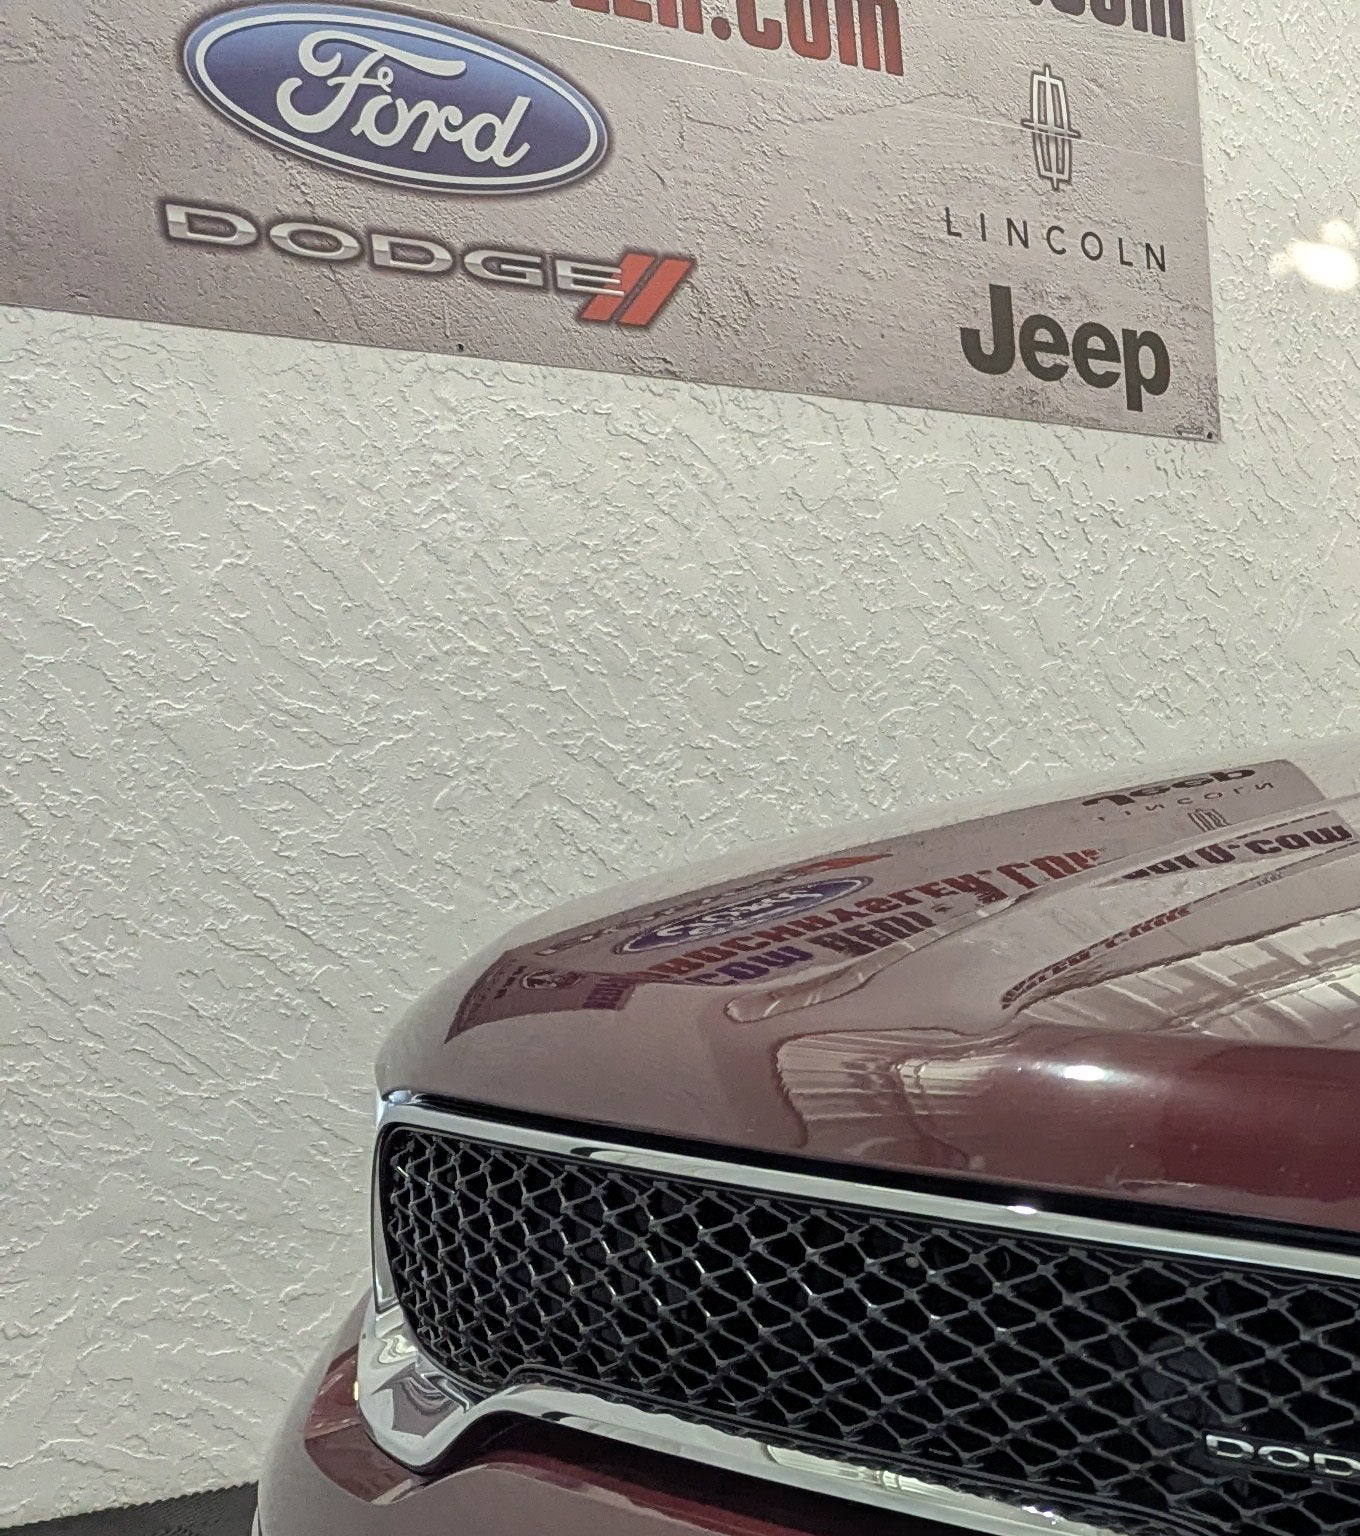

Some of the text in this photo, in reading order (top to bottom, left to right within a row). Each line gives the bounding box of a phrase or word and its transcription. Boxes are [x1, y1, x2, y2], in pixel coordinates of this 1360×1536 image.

[277, 30, 532, 168] Ford
[164, 203, 625, 298] DODGE
[945, 206, 1167, 272] LINCOLN
[959, 283, 1171, 412] Jeep
